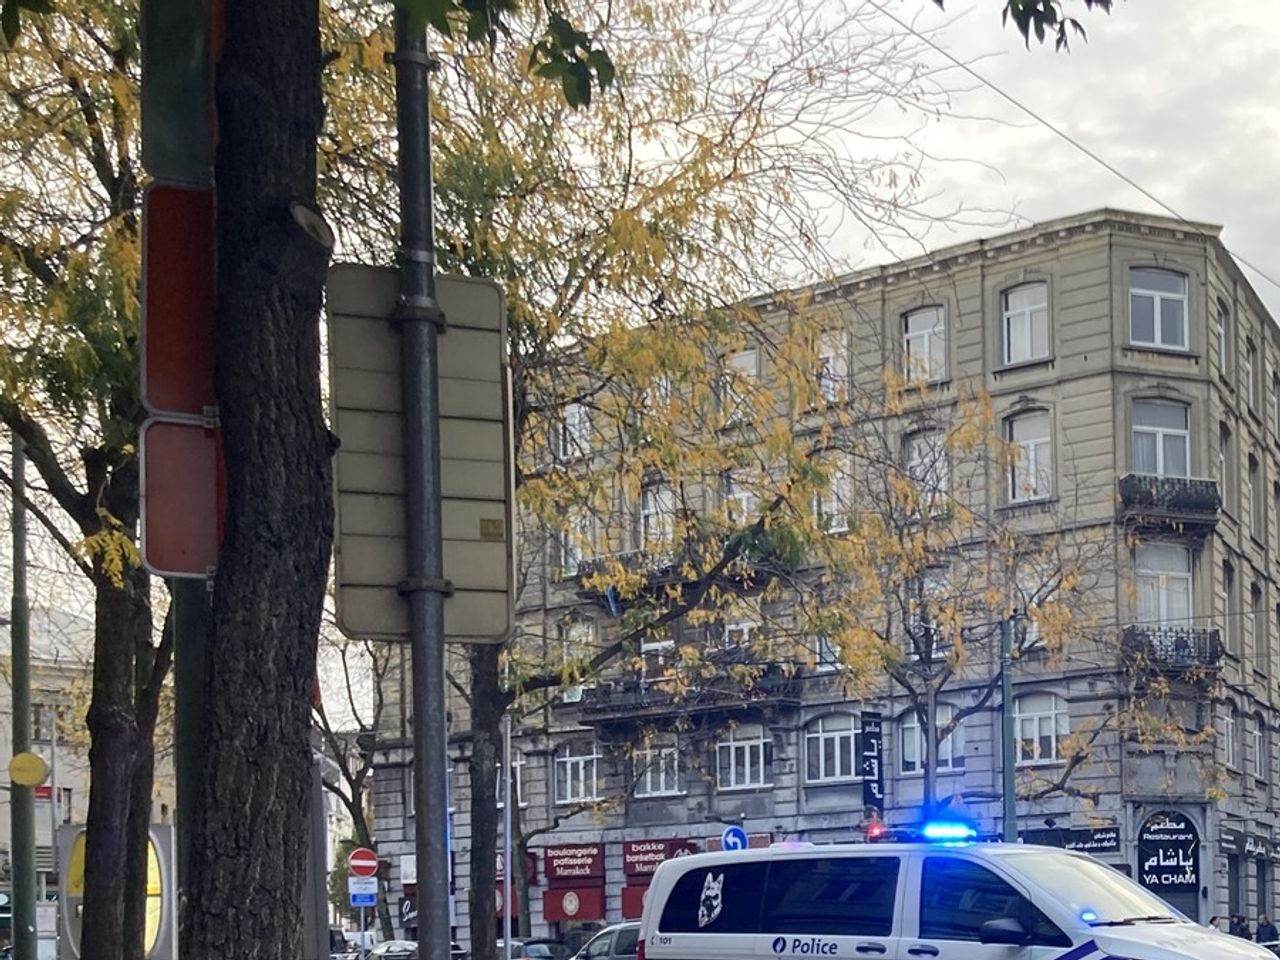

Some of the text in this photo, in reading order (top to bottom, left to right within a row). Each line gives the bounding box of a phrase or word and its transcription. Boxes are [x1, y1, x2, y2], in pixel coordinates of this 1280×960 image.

[1143, 833, 1193, 841] Restaurant
[547, 847, 598, 857] boulangerie
[1143, 874, 1196, 884] YA CHAM
[659, 937, 672, 945] 101
[791, 938, 838, 955] Police
